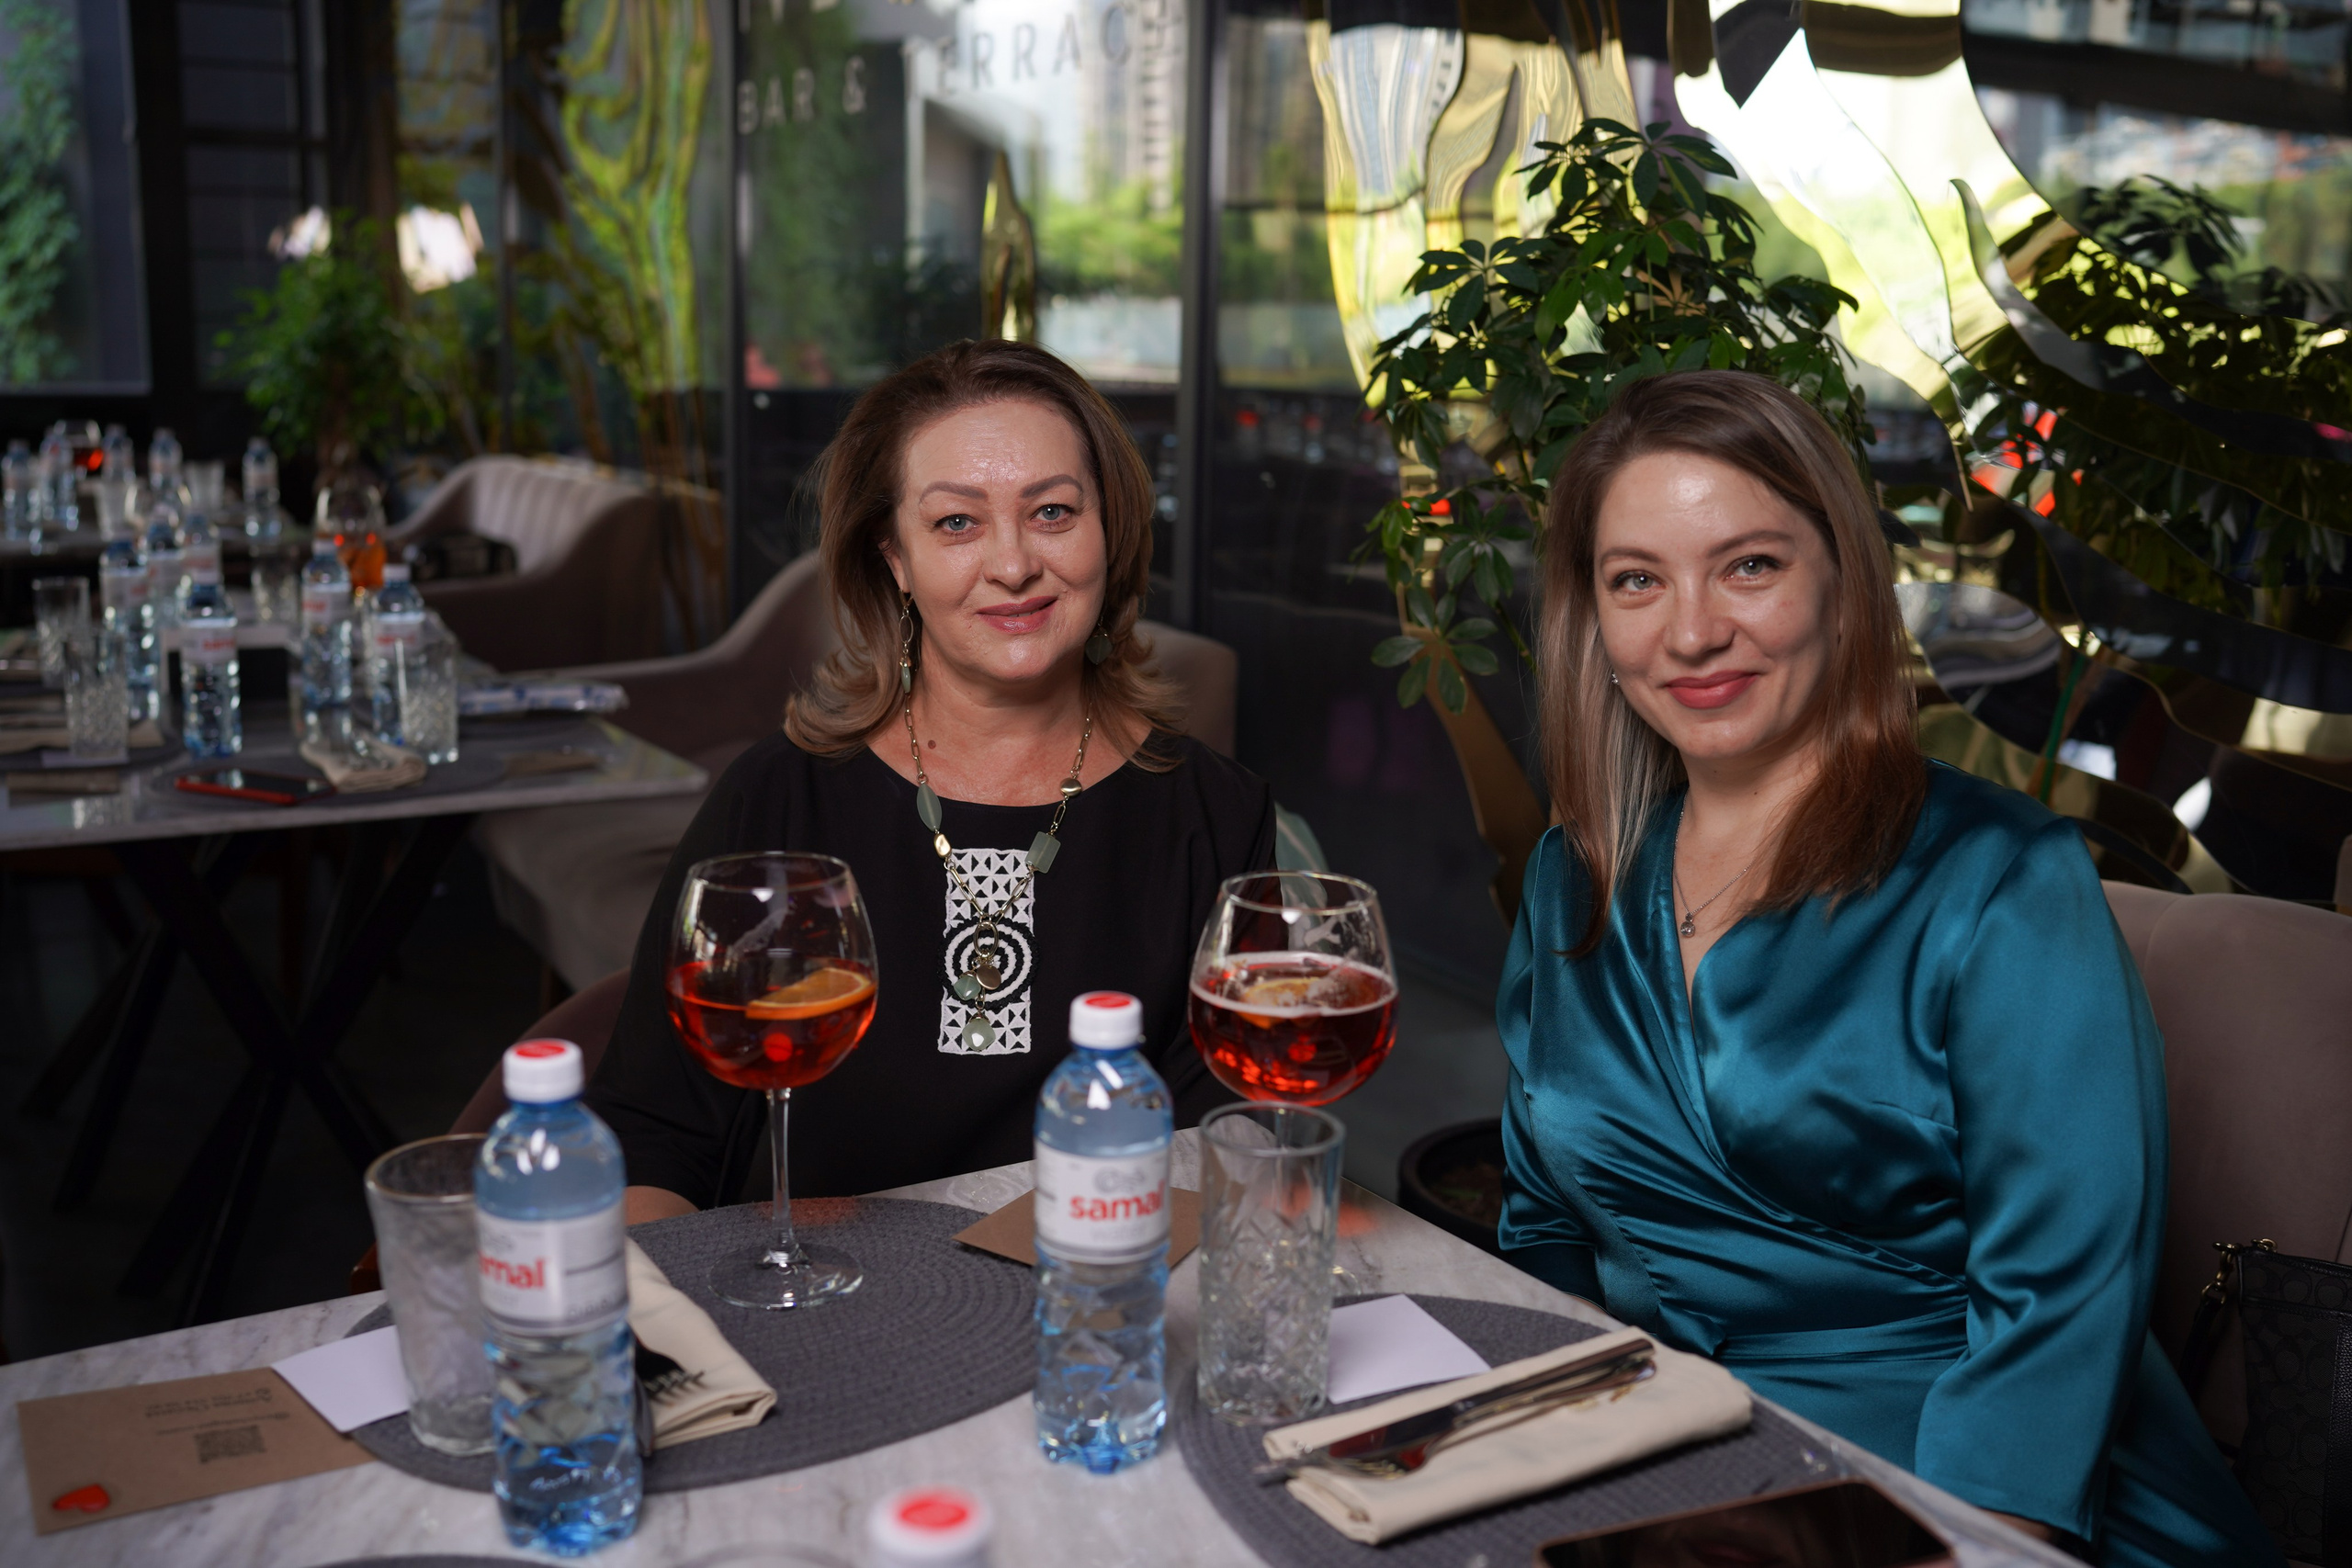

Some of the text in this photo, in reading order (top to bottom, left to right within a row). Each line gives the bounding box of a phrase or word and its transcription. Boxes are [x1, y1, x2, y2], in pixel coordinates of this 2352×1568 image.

[738, 66, 815, 135] BAR
[842, 55, 866, 115] &
[1070, 1179, 1165, 1222] samal
